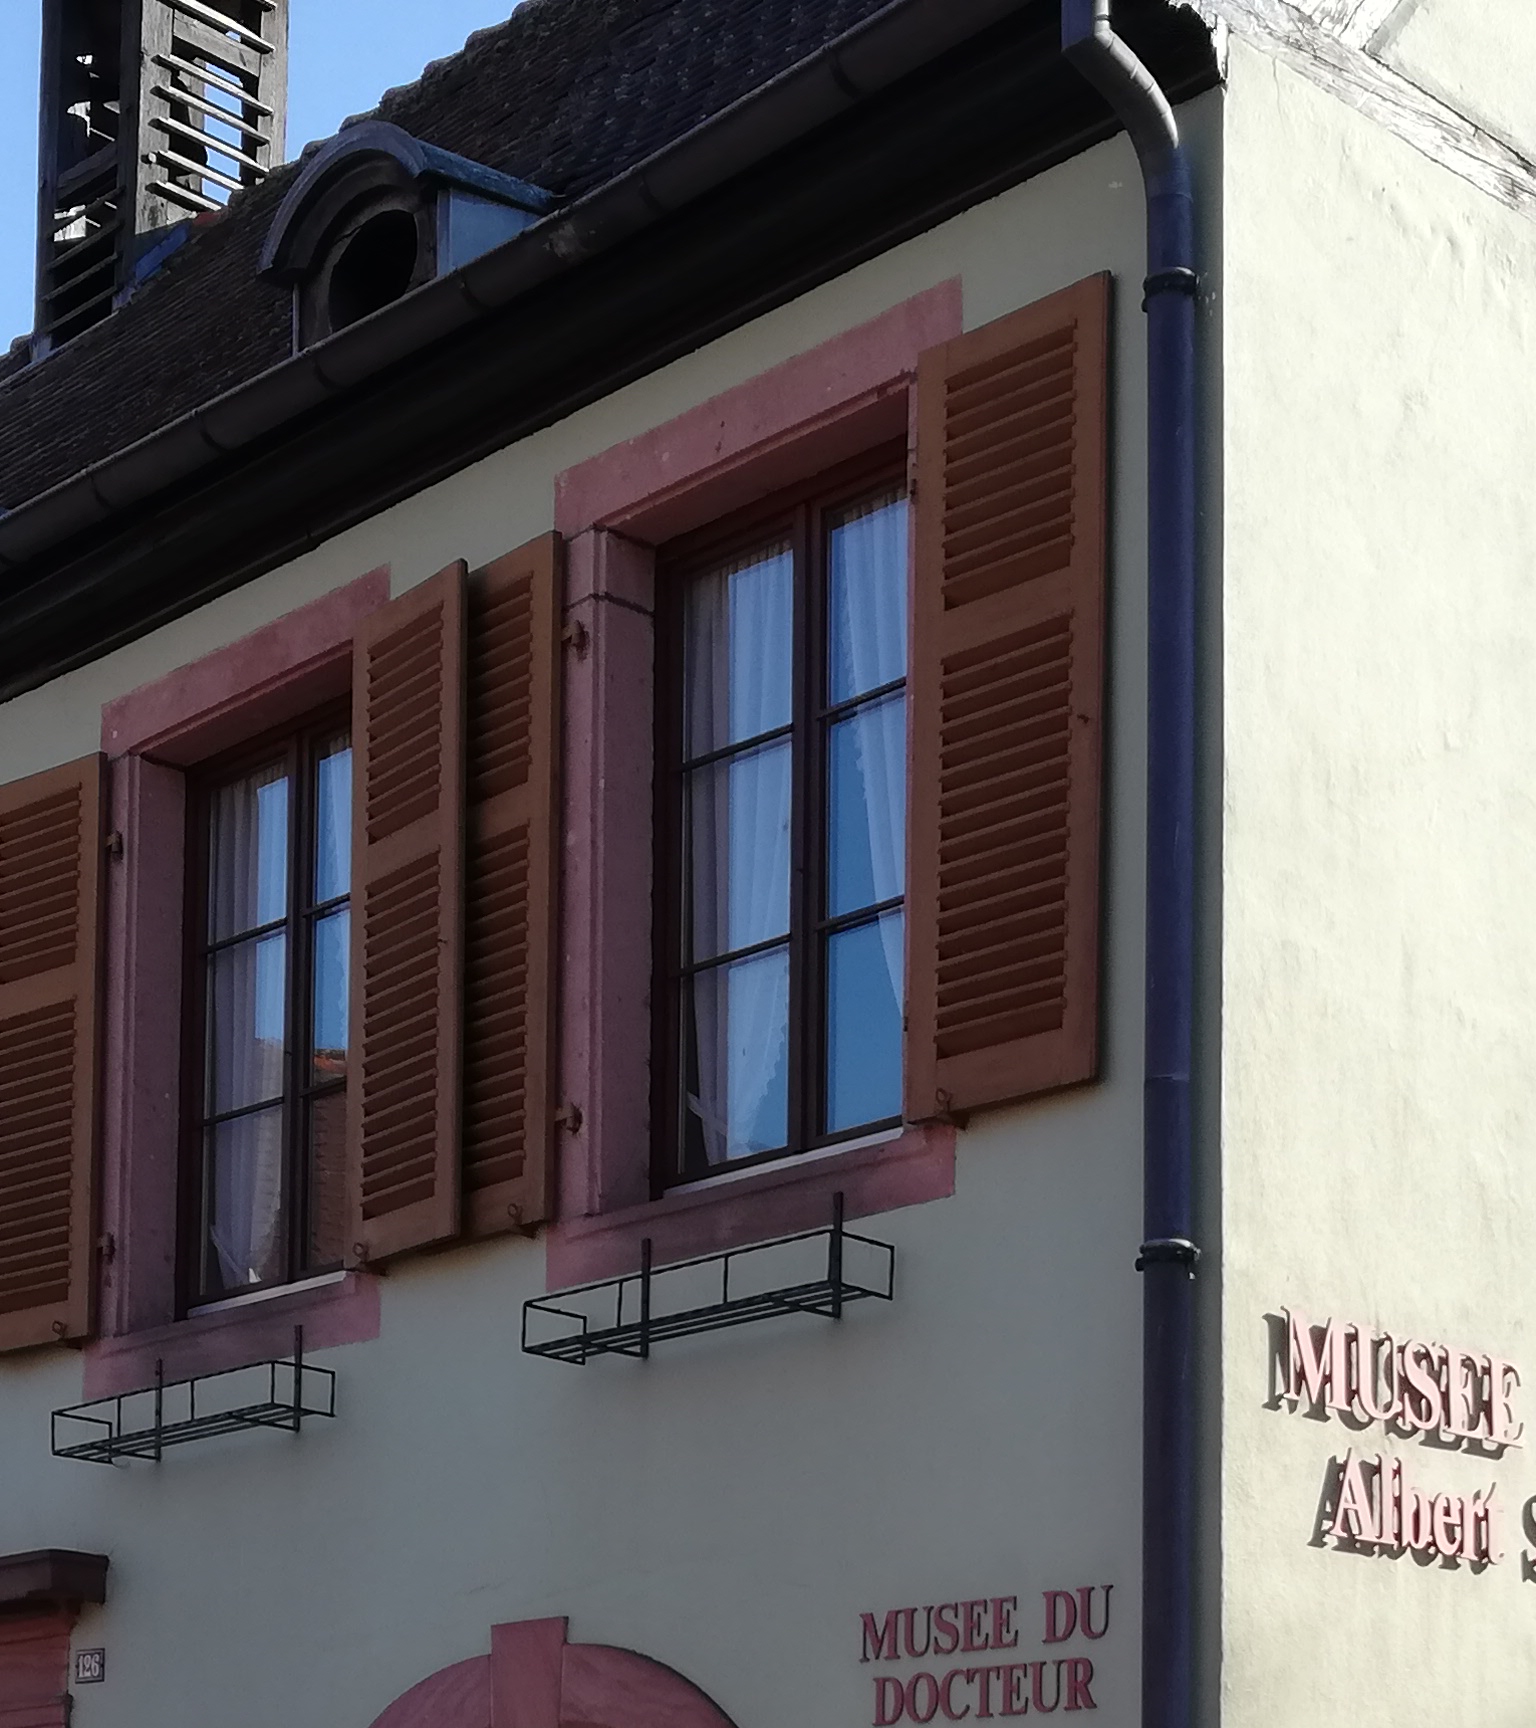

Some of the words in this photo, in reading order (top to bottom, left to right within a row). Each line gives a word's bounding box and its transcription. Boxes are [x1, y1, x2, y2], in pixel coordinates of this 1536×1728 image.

[1280, 1304, 1524, 1449] MUSEE
[1328, 1447, 1506, 1566] Albert
[859, 1596, 1019, 1663] MUSEE
[1042, 1584, 1114, 1644] DU
[78, 1653, 100, 1679] 126
[871, 1657, 1098, 1727] DOCTEUR
